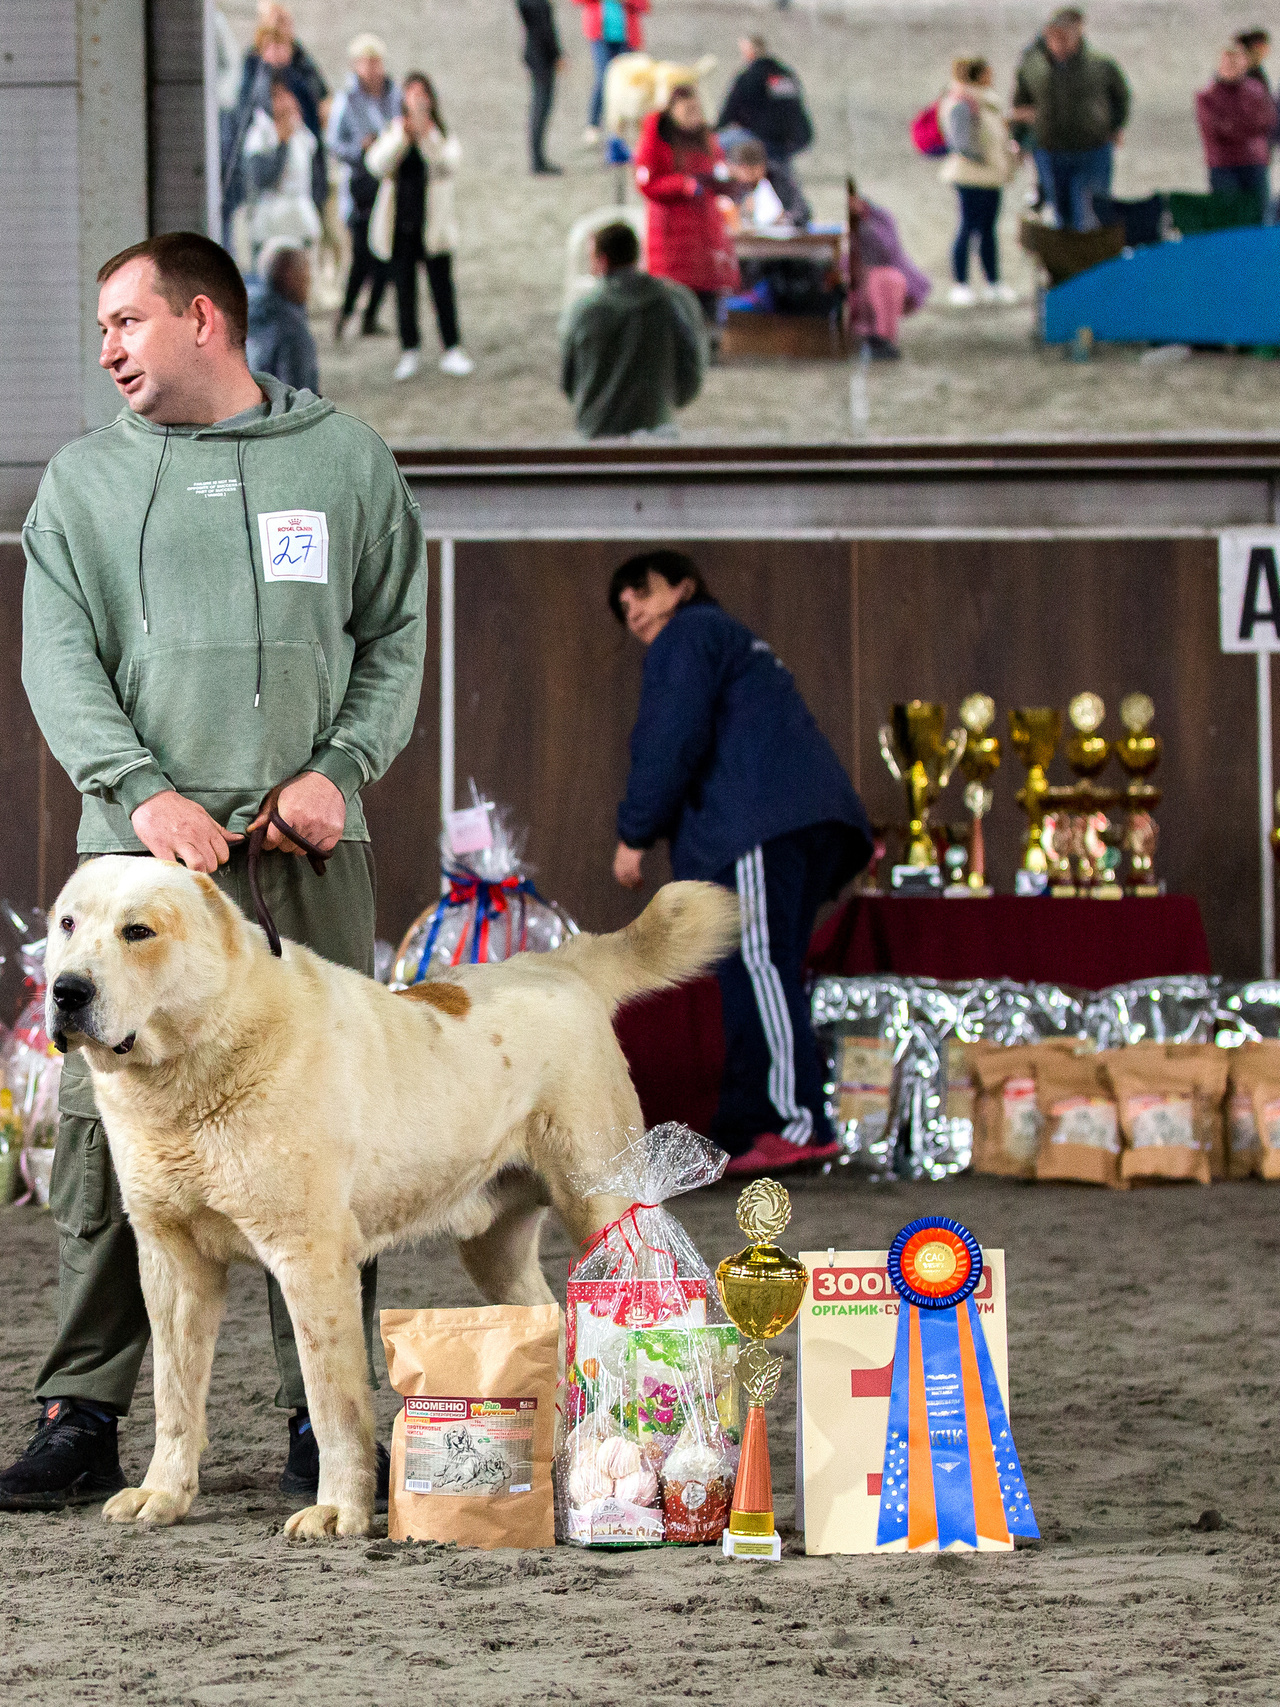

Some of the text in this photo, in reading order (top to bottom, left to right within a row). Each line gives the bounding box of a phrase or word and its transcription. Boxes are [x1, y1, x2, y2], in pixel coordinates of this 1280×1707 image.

[272, 534, 318, 566] 27
[1238, 547, 1280, 639] A
[409, 1401, 464, 1411] ЗООМЕНЮ
[484, 1402, 500, 1410] Био
